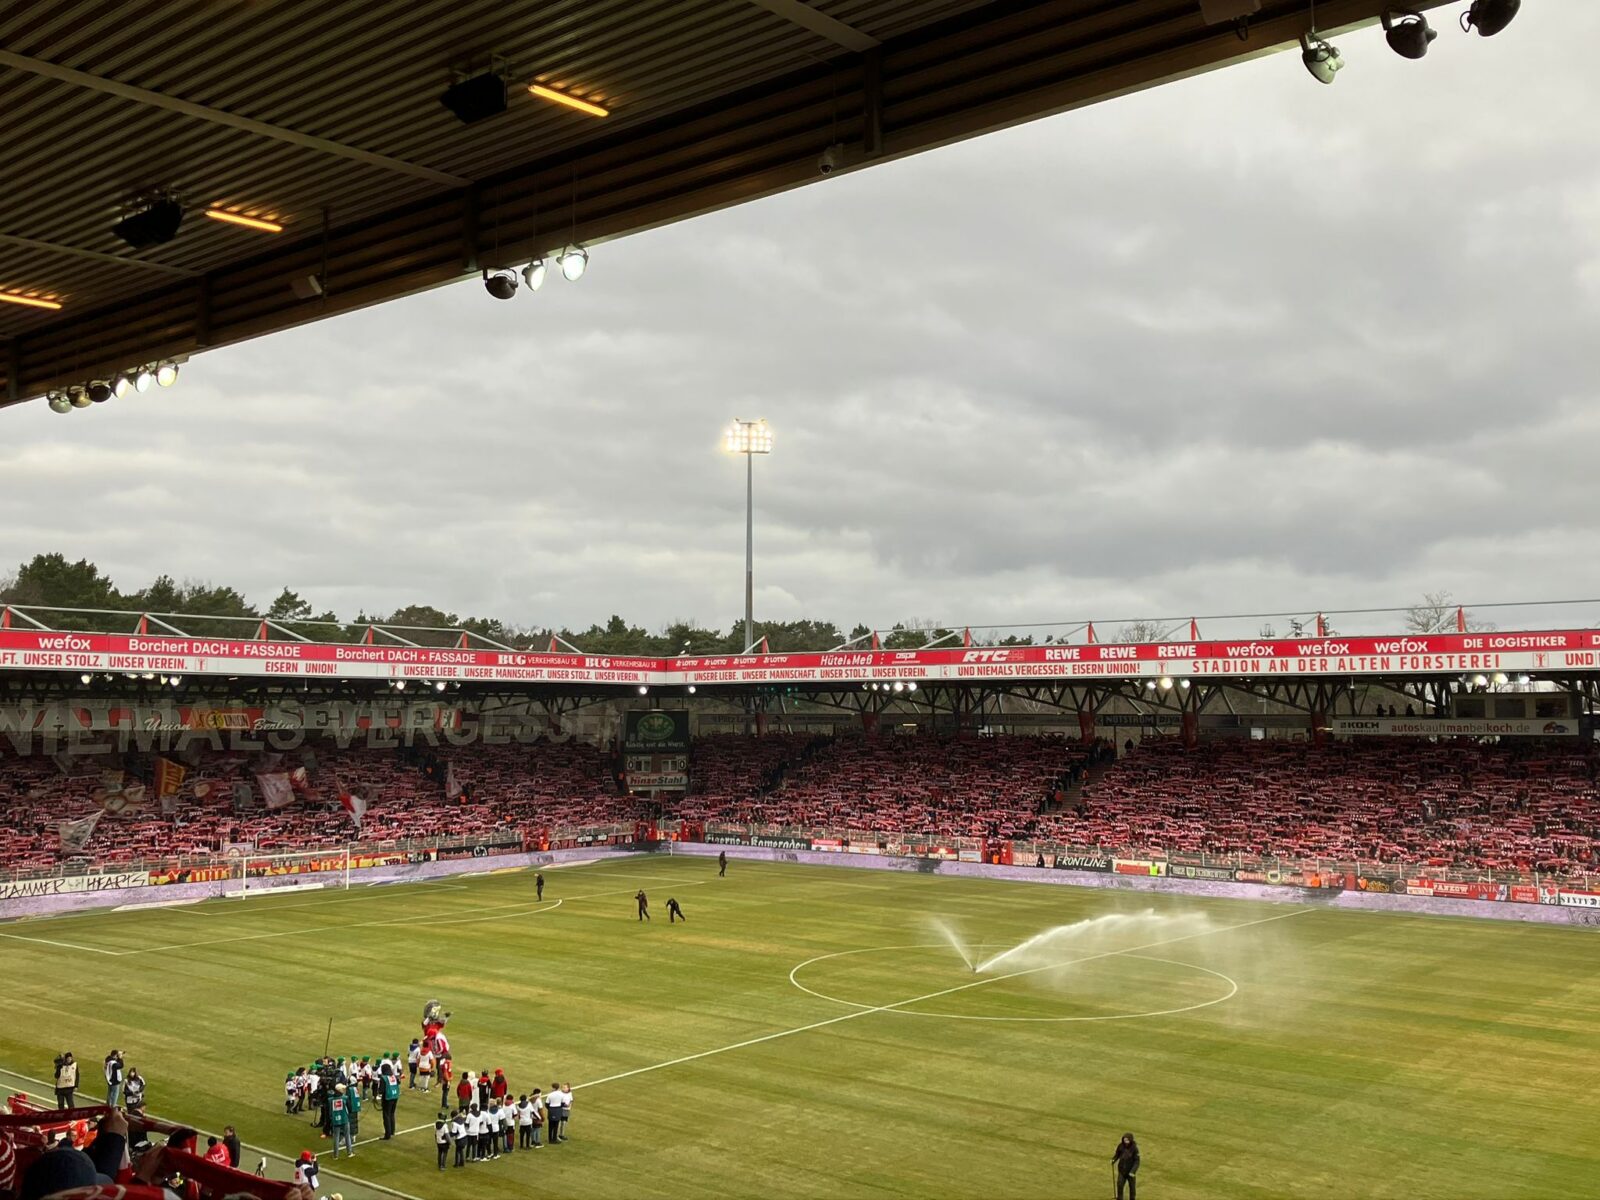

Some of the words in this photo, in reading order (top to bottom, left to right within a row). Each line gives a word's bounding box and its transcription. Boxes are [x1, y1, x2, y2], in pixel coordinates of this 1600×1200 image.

[38, 635, 91, 650] wefox
[129, 638, 189, 654] Borchert
[192, 642, 229, 655] DACH
[232, 646, 240, 655] +
[243, 644, 301, 657] FASSADE
[1298, 640, 1350, 655] wefox
[1374, 638, 1428, 653] wefox
[1464, 638, 1483, 649] DIE
[1489, 636, 1566, 648] LOGISTIKER
[336, 648, 384, 660] Borchert
[388, 650, 418, 662] DACH
[429, 652, 476, 664] FASSADE
[962, 650, 1010, 662] RTC
[1046, 649, 1080, 660] REWE
[1100, 647, 1137, 660] REWE
[1158, 645, 1196, 658] REWE
[1226, 643, 1274, 656] wefox
[24, 653, 62, 666] UNSER
[66, 654, 102, 668] STOLZ.
[109, 656, 144, 668] UNSER
[148, 657, 188, 670] VEREIN.
[498, 654, 526, 666] BUG
[528, 656, 570, 666] VERKEHRSBAU
[585, 658, 611, 668] BUG
[740, 657, 758, 665] LOTTO
[1193, 660, 1260, 673] STADION
[1269, 659, 1288, 672] AN
[1298, 658, 1328, 672] DER
[1338, 656, 1390, 672] ALTEN
[1400, 654, 1500, 670] FÖRSTEREI
[1565, 652, 1594, 666] UND
[265, 662, 298, 672] EISERN
[306, 663, 337, 674] UNION!
[404, 666, 434, 677] UNSERE
[436, 666, 460, 677] LIEBE.
[464, 667, 494, 678] UNSERE
[496, 668, 544, 680] MANNSCHAFT.
[547, 670, 570, 680] UNSER
[570, 670, 592, 680] STOLZ.
[594, 670, 615, 680] UNSER
[616, 672, 640, 682] VEREIN.
[694, 672, 718, 682] UNSERE
[719, 671, 739, 681] LIEBE.
[742, 670, 767, 680] UNSERE
[770, 668, 816, 680] MANNSCHAFT.
[820, 668, 843, 678] UNSER
[845, 667, 869, 678] STOLZ.
[872, 666, 896, 678] UNSER
[898, 666, 928, 678] VEREIN.
[958, 665, 975, 676] UND
[977, 664, 1014, 676] NIEMALS
[1015, 663, 1068, 675] VERGESSEN:
[1072, 663, 1106, 674] EISERN
[1106, 662, 1140, 674] UNION!
[1348, 721, 1380, 729] KOCH
[1056, 856, 1107, 868] FRONTLINE
